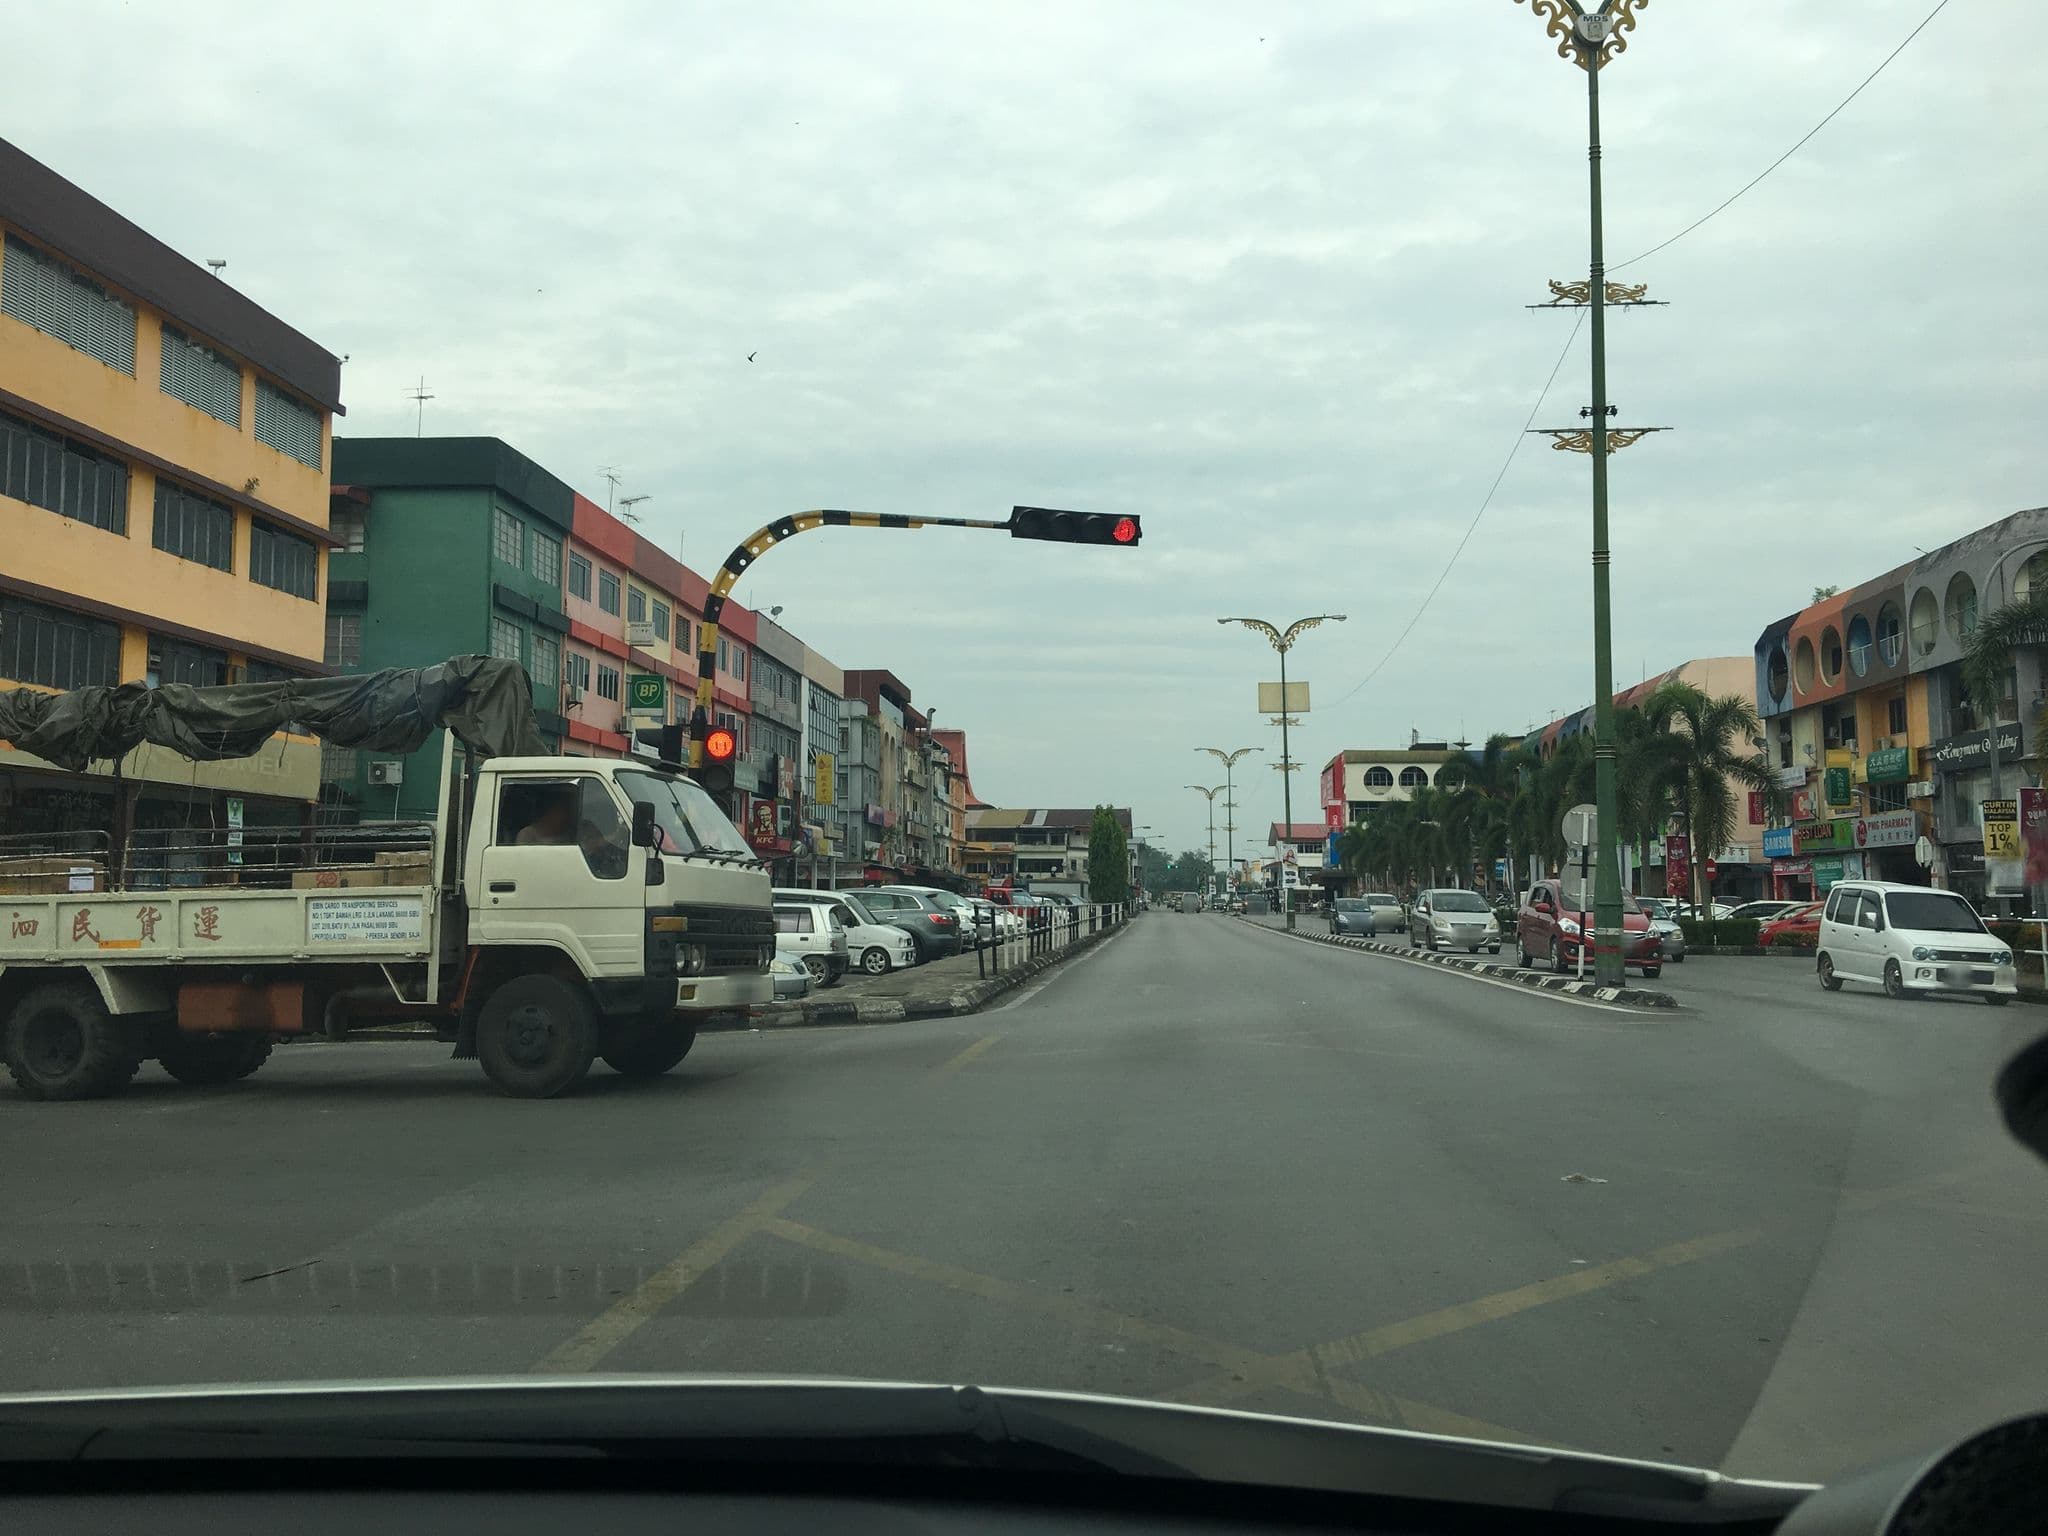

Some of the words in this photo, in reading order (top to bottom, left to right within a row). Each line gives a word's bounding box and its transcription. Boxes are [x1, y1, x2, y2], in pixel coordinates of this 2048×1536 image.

[639, 683, 657, 697] BP
[1983, 801, 2016, 809] CURTIN
[1880, 816, 1913, 830] PHARMACY
[1988, 823, 2011, 833] TOP
[1815, 823, 1833, 838] LOAN
[755, 836, 775, 844] KFC
[1989, 833, 2013, 851] 1%
[341, 901, 376, 909] TRANSPORTING
